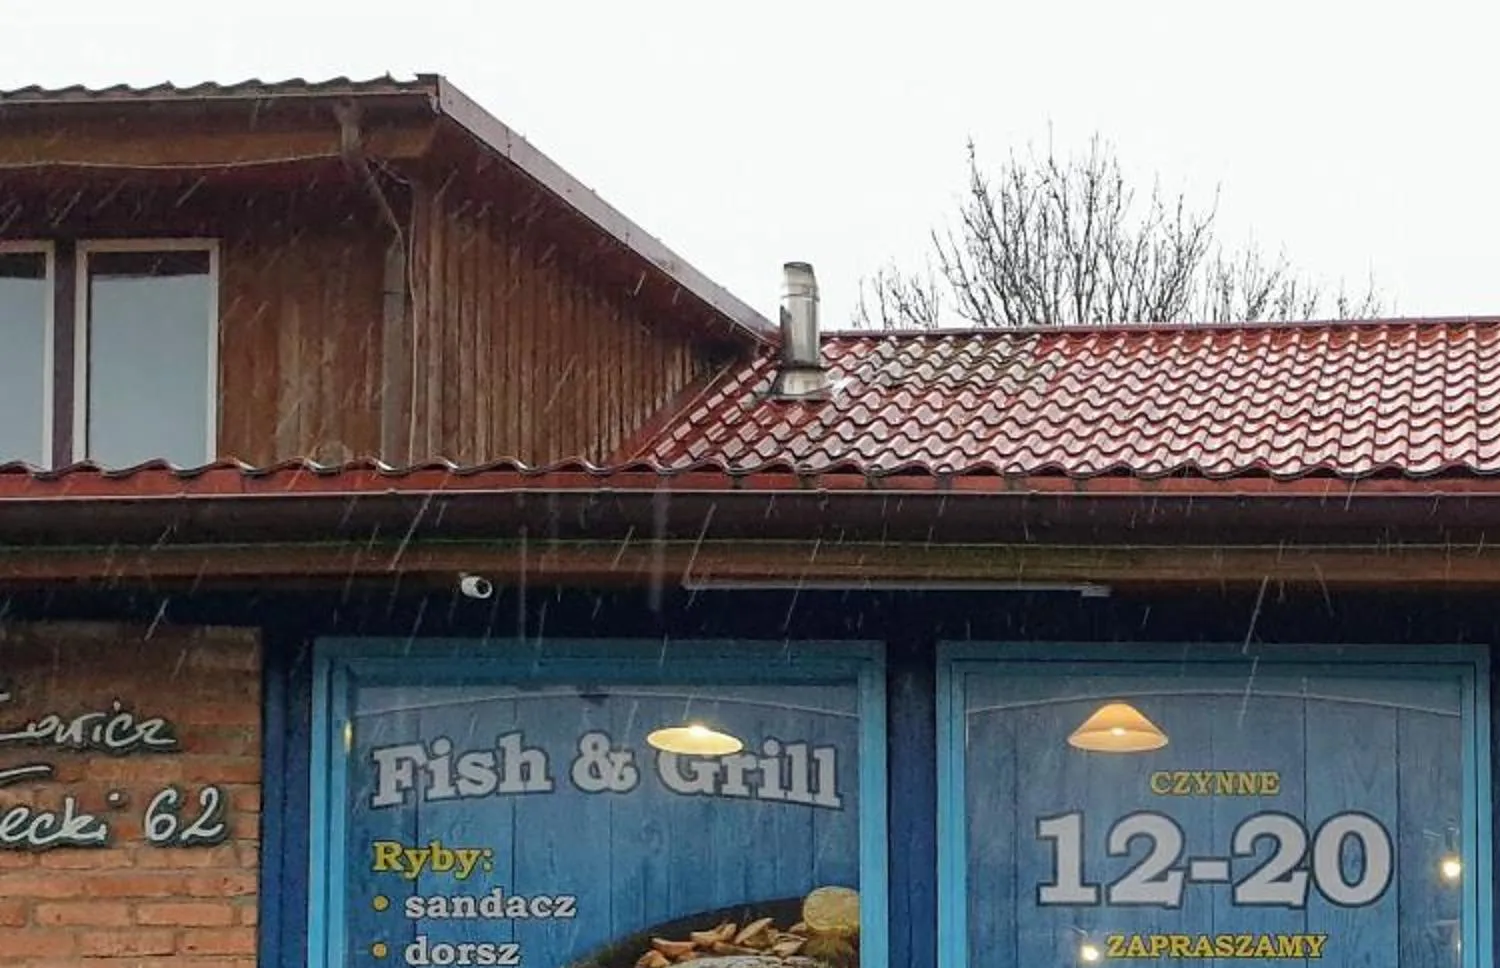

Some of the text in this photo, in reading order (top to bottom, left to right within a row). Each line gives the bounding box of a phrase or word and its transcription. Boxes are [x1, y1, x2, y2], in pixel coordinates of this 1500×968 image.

[373, 731, 844, 810] Fish & Grill
[1150, 769, 1281, 797] CZYNNE
[144, 786, 225, 841] 62
[372, 841, 494, 878] Ryby:
[1036, 810, 1394, 909] 12-20
[404, 887, 577, 919] sandacz
[404, 936, 520, 966] dorsz
[1105, 933, 1328, 960] ZAPRASZAMY
